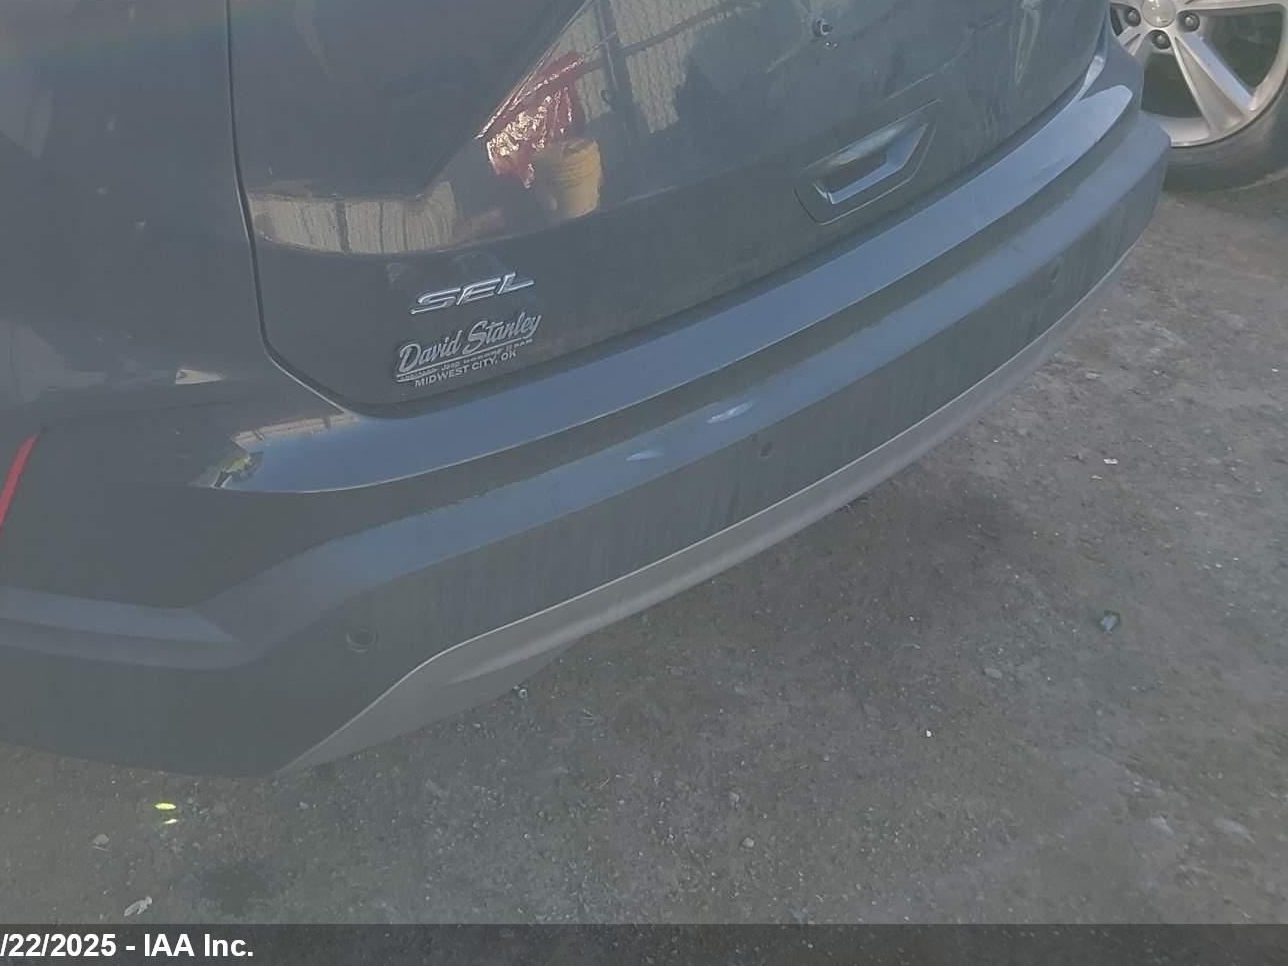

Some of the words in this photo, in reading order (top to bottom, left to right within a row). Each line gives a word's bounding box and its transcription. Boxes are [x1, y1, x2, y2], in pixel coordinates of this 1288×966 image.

[410, 272, 534, 314] SEL
[399, 329, 463, 372] David
[462, 312, 542, 354] Stanley
[415, 365, 469, 387] MIDWEST
[471, 353, 498, 370] CITY,
[501, 349, 517, 361] OK
